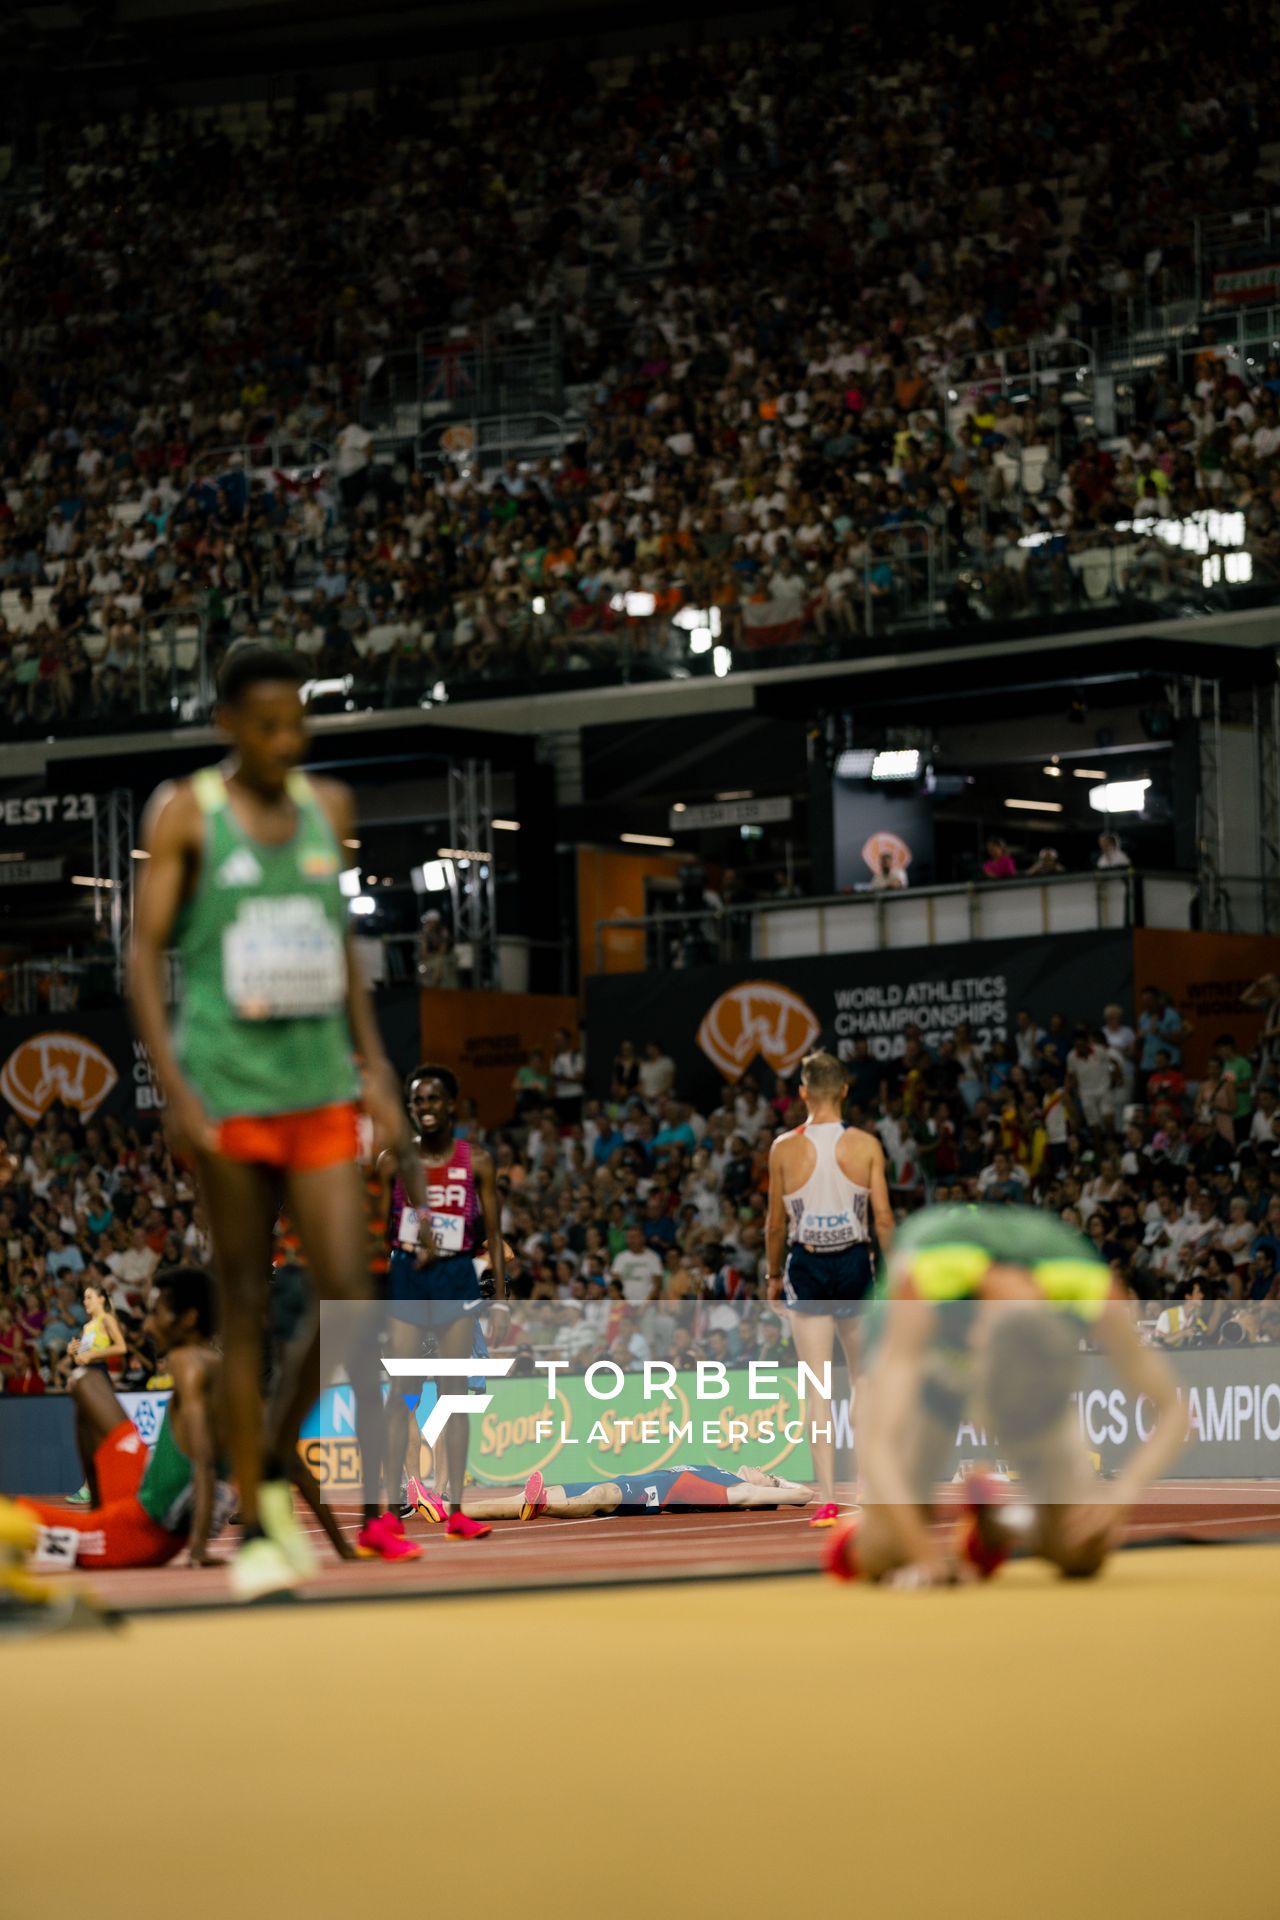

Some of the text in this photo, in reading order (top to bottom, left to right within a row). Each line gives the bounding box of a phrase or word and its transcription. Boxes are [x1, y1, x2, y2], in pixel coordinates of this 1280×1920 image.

[62, 793, 96, 820] 23
[834, 976, 1007, 1010] WORLD ATHLETICS
[834, 1001, 1007, 1036] CHAMPIONSHIPS
[426, 1184, 466, 1208] SA
[815, 1212, 850, 1228] TDK
[480, 1401, 555, 1458] Sport
